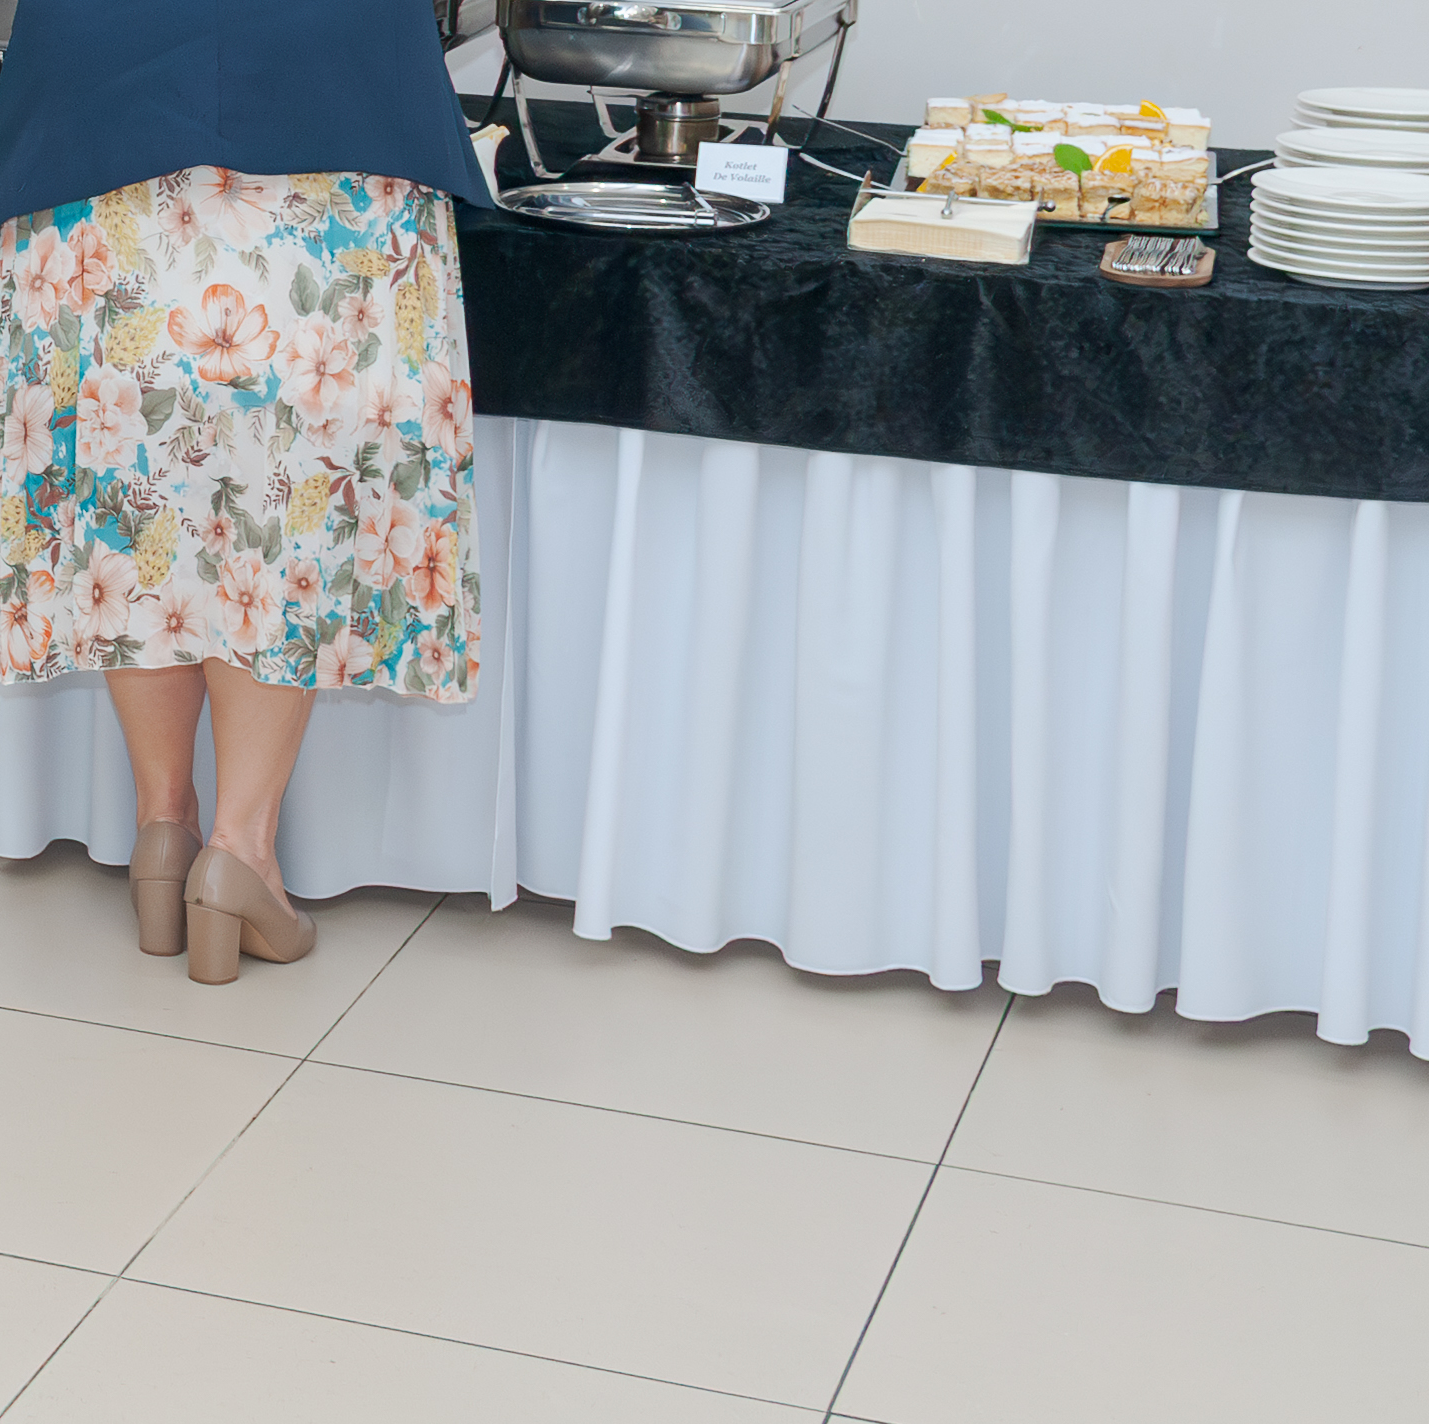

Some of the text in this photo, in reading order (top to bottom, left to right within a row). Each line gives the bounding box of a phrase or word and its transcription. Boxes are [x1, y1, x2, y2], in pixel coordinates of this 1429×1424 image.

[724, 161, 757, 171] Kotlet
[713, 172, 772, 184] De Volaille
